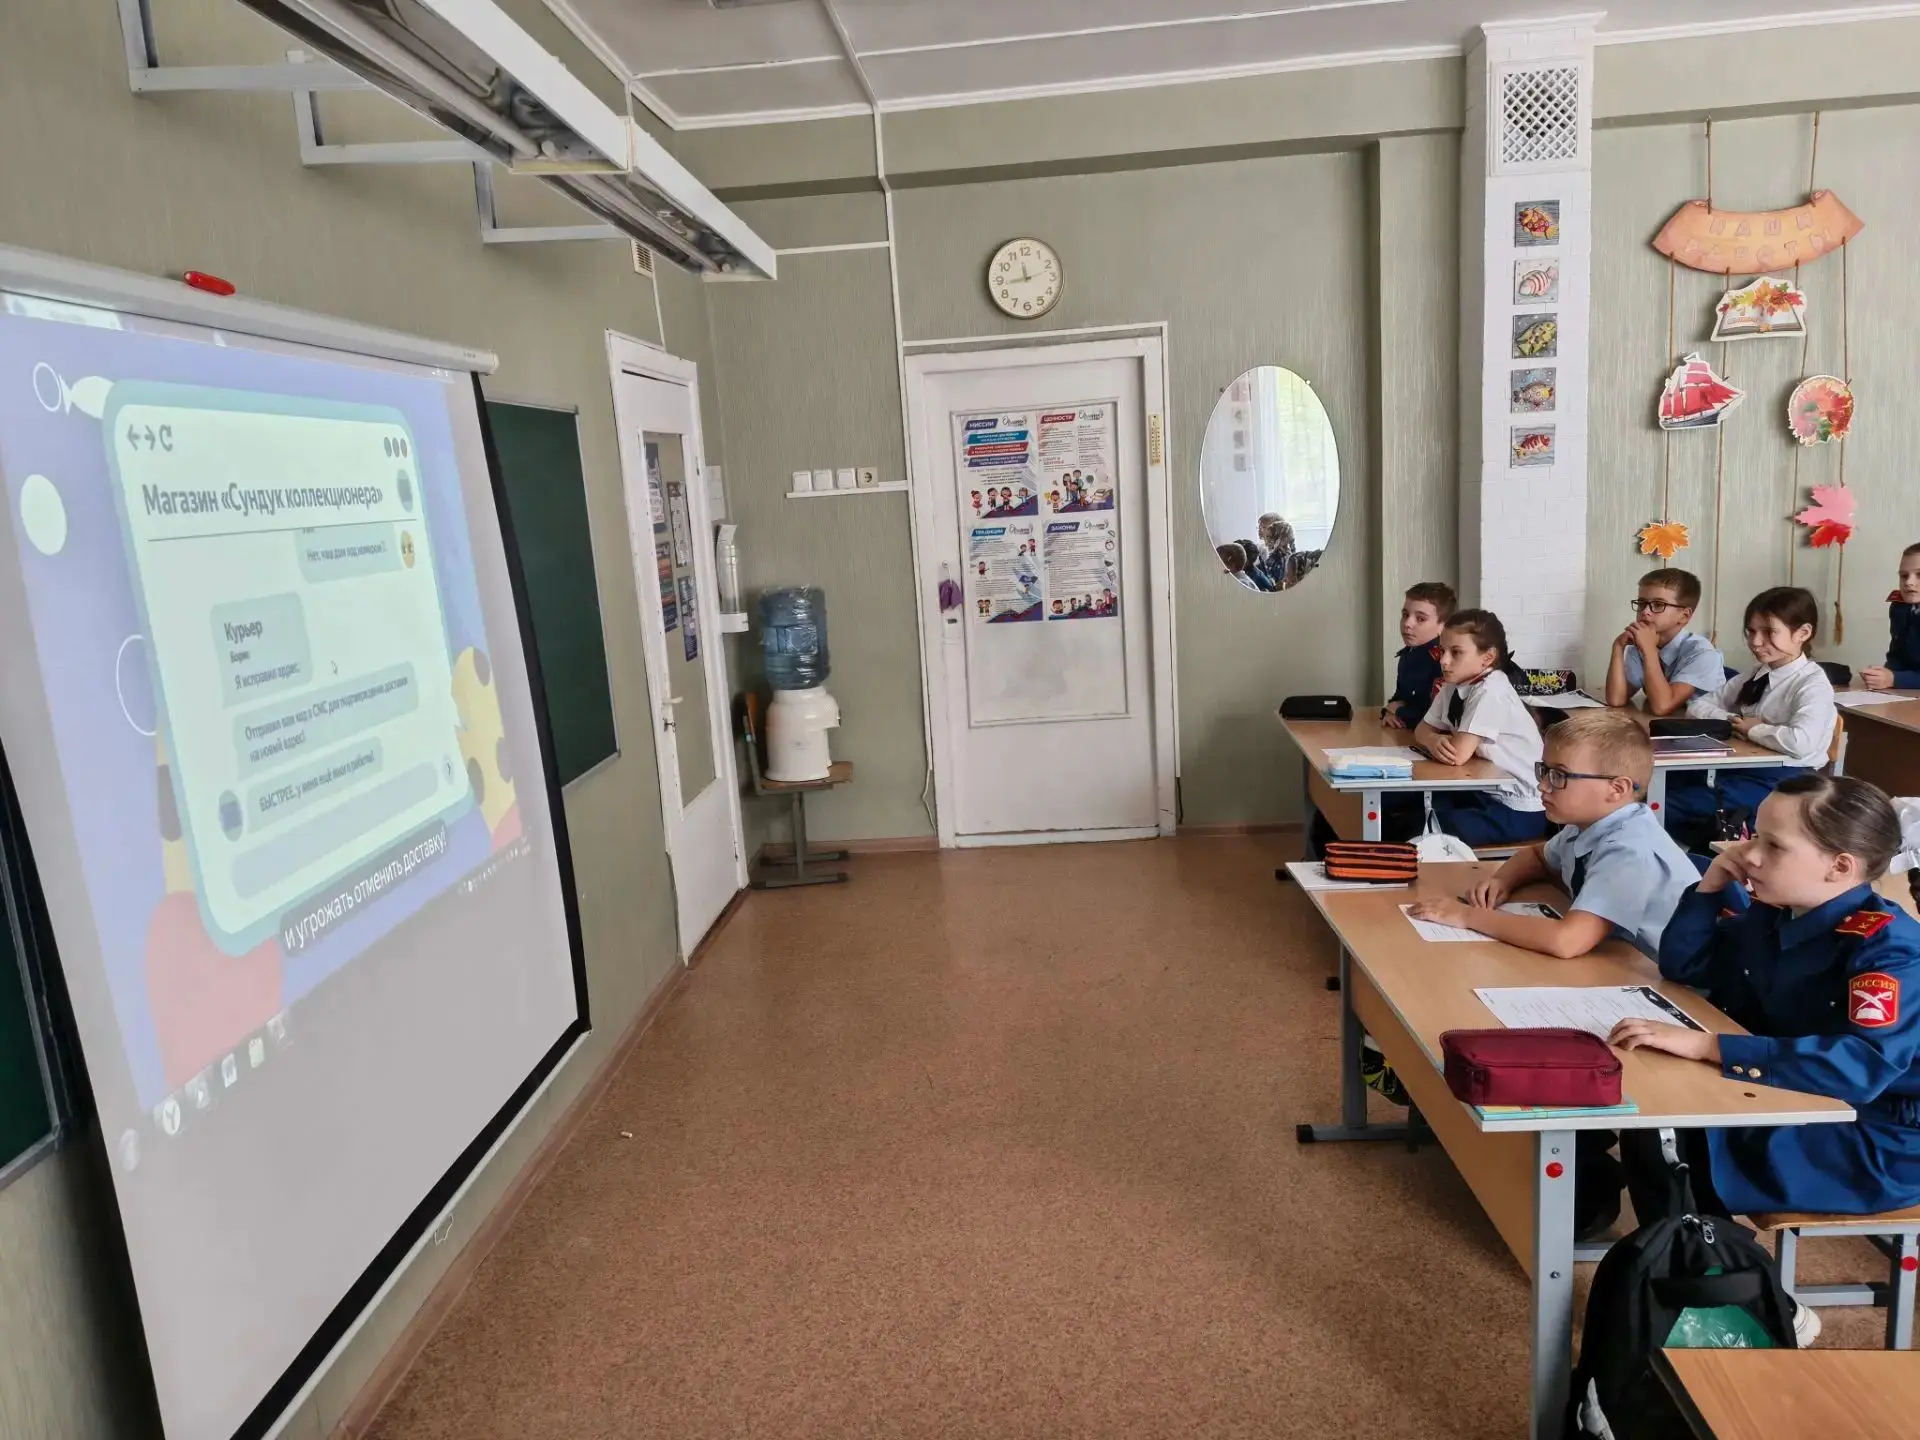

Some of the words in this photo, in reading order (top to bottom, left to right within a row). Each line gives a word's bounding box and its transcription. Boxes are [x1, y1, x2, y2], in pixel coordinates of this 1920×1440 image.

[1008, 251, 1017, 261] 11
[1019, 246, 1031, 257] 12
[1036, 250, 1041, 260] 1
[1000, 262, 1011, 272] 10
[1044, 260, 1052, 269] 2
[995, 275, 1004, 285] 9
[1049, 272, 1057, 282] 3
[1001, 289, 1009, 299] 8
[1045, 287, 1053, 296] 4
[1011, 298, 1019, 308] 7
[1023, 301, 1032, 311] 6
[1036, 296, 1045, 306] 5
[142, 483, 219, 516] Магазин
[221, 482, 285, 517] «Сундук
[286, 485, 384, 510] коллекционера»
[224, 620, 263, 644] Курьер
[235, 674, 242, 690] Я
[242, 667, 277, 688] исправил
[312, 700, 329, 718] СМС
[328, 700, 340, 715] для
[250, 749, 260, 763] на
[260, 738, 284, 760] новый
[319, 769, 333, 786] ещё
[284, 929, 296, 951] и
[295, 891, 354, 949] угрожать
[353, 859, 403, 904] отменить
[402, 824, 448, 877] доставку!
[1852, 979, 1897, 992] РОССИЯ
